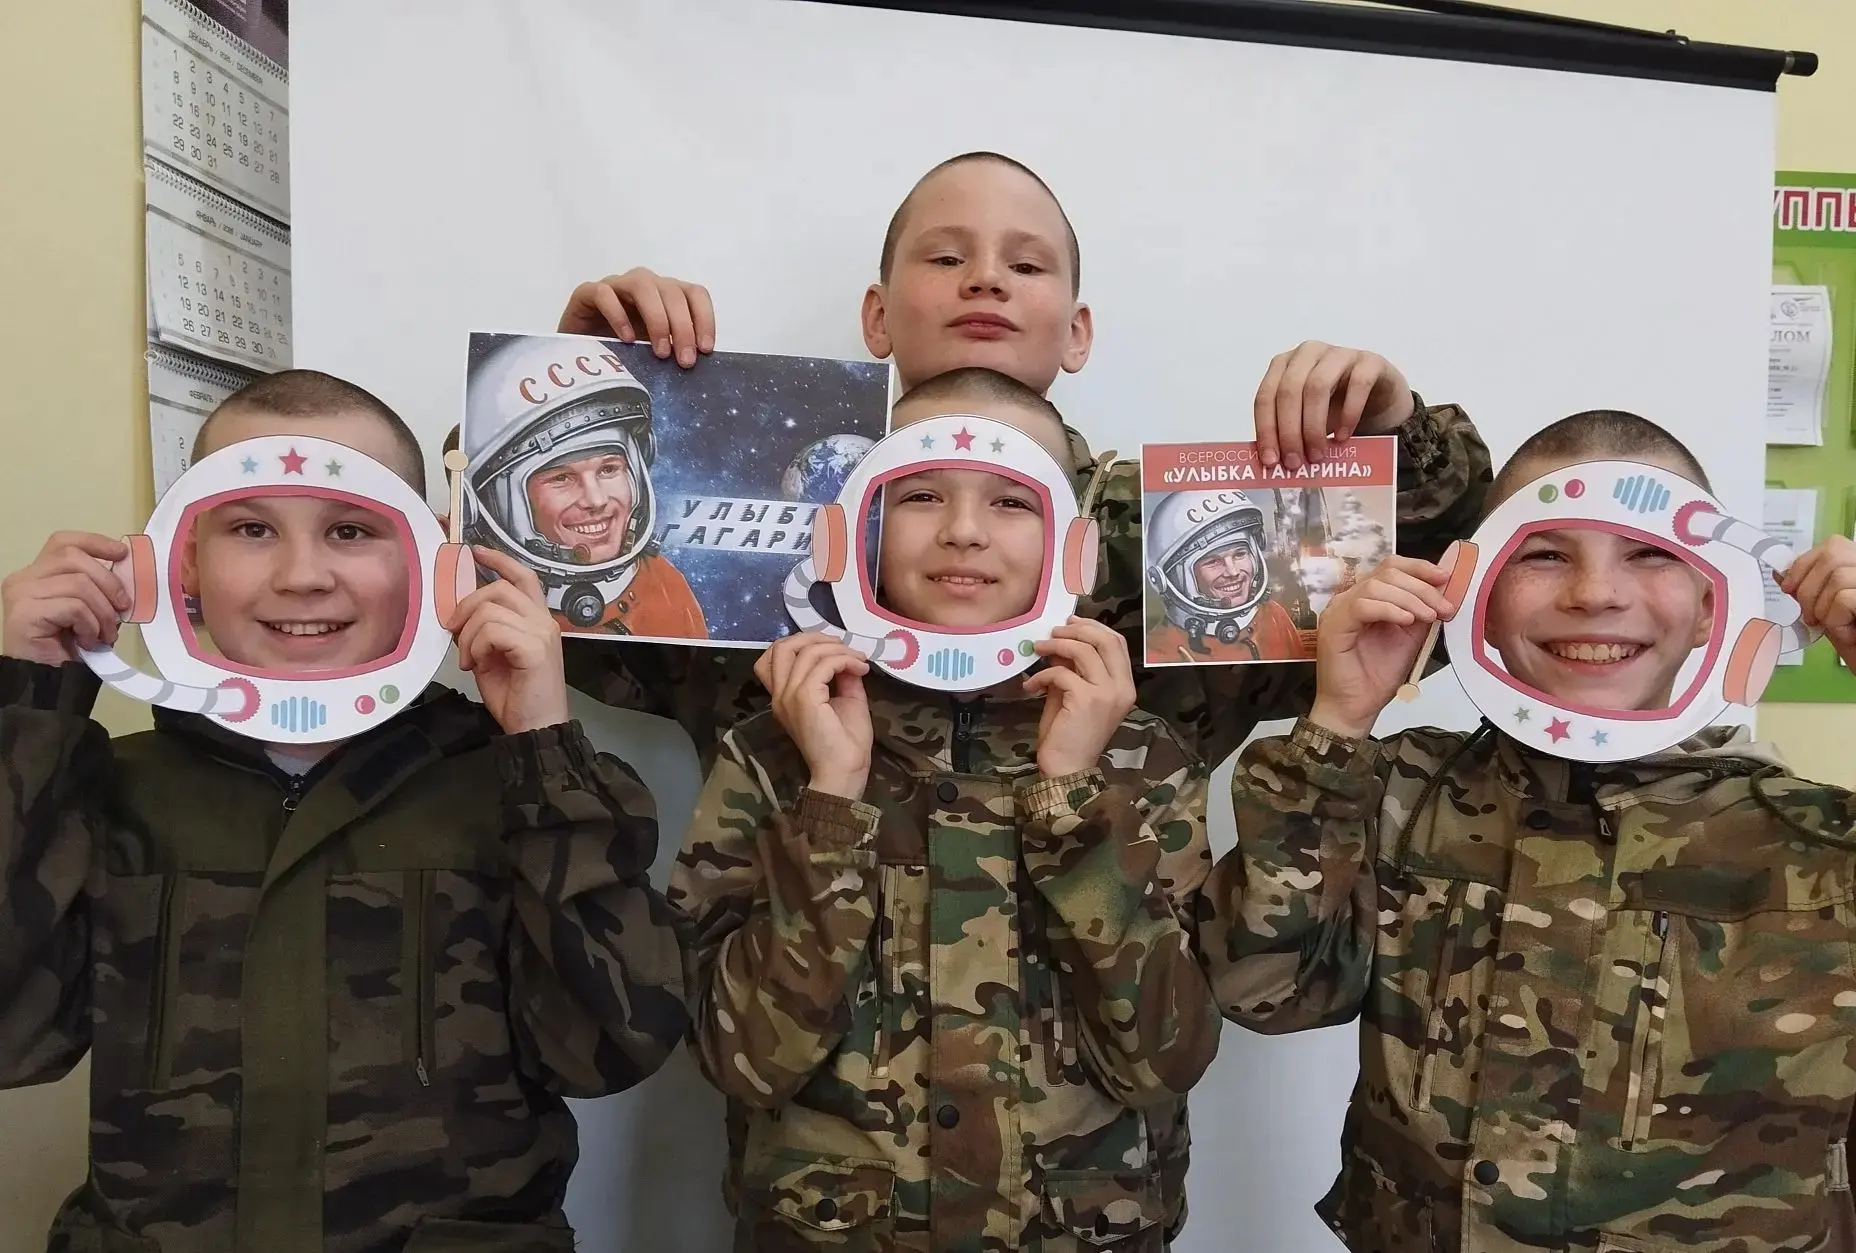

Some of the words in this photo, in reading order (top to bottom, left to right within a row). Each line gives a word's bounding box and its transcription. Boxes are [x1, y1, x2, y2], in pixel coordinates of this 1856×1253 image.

[173, 70, 179, 84] 8
[191, 82, 196, 95] 9
[205, 91, 215, 107] 10
[222, 101, 230, 117] 11
[238, 111, 247, 127] 12
[190, 60, 195, 73] 2
[207, 71, 212, 84] 3
[223, 82, 228, 92] 4
[239, 91, 244, 104] 5
[172, 92, 182, 108] 15
[190, 102, 199, 118] 16
[206, 112, 215, 127] 17
[222, 122, 232, 138] 18
[238, 132, 248, 147] 19
[172, 113, 183, 130] 22
[190, 123, 200, 140] 23
[206, 133, 216, 149] 24
[222, 142, 233, 159] 25
[239, 151, 249, 168] 26
[173, 135, 184, 152] 29
[190, 145, 201, 161] 30
[207, 154, 217, 168] 31
[1773, 188, 1856, 231] ПП
[178, 253, 184, 266] 5
[195, 260, 201, 273] 6
[213, 267, 219, 280] 7
[257, 288, 267, 301] 10
[272, 293, 279, 306] 11
[242, 260, 247, 274] 2
[257, 267, 263, 280] 3
[178, 274, 189, 290] 12
[195, 281, 207, 296] 13
[213, 287, 224, 302] 14
[231, 294, 241, 309] 15
[180, 296, 191, 311] 19
[197, 302, 209, 318] 20
[215, 308, 225, 325] 21
[232, 315, 243, 330] 22
[248, 320, 260, 335] 23
[183, 317, 194, 333] 26
[201, 323, 211, 338] 27
[217, 330, 229, 344] 28
[234, 335, 246, 350] 29
[251, 340, 263, 355] 30
[1771, 330, 1811, 342] ЛОМ
[519, 354, 624, 405] СССР
[179, 436, 184, 450] 2
[1179, 449, 1258, 464] ВСЕРОССИ
[1326, 446, 1357, 459] ЦИЯ
[181, 458, 187, 472] 9
[1163, 464, 1255, 483] «УЛЫБКА
[1187, 491, 1247, 523] СССР
[658, 523, 812, 551] ГАГАРИ
